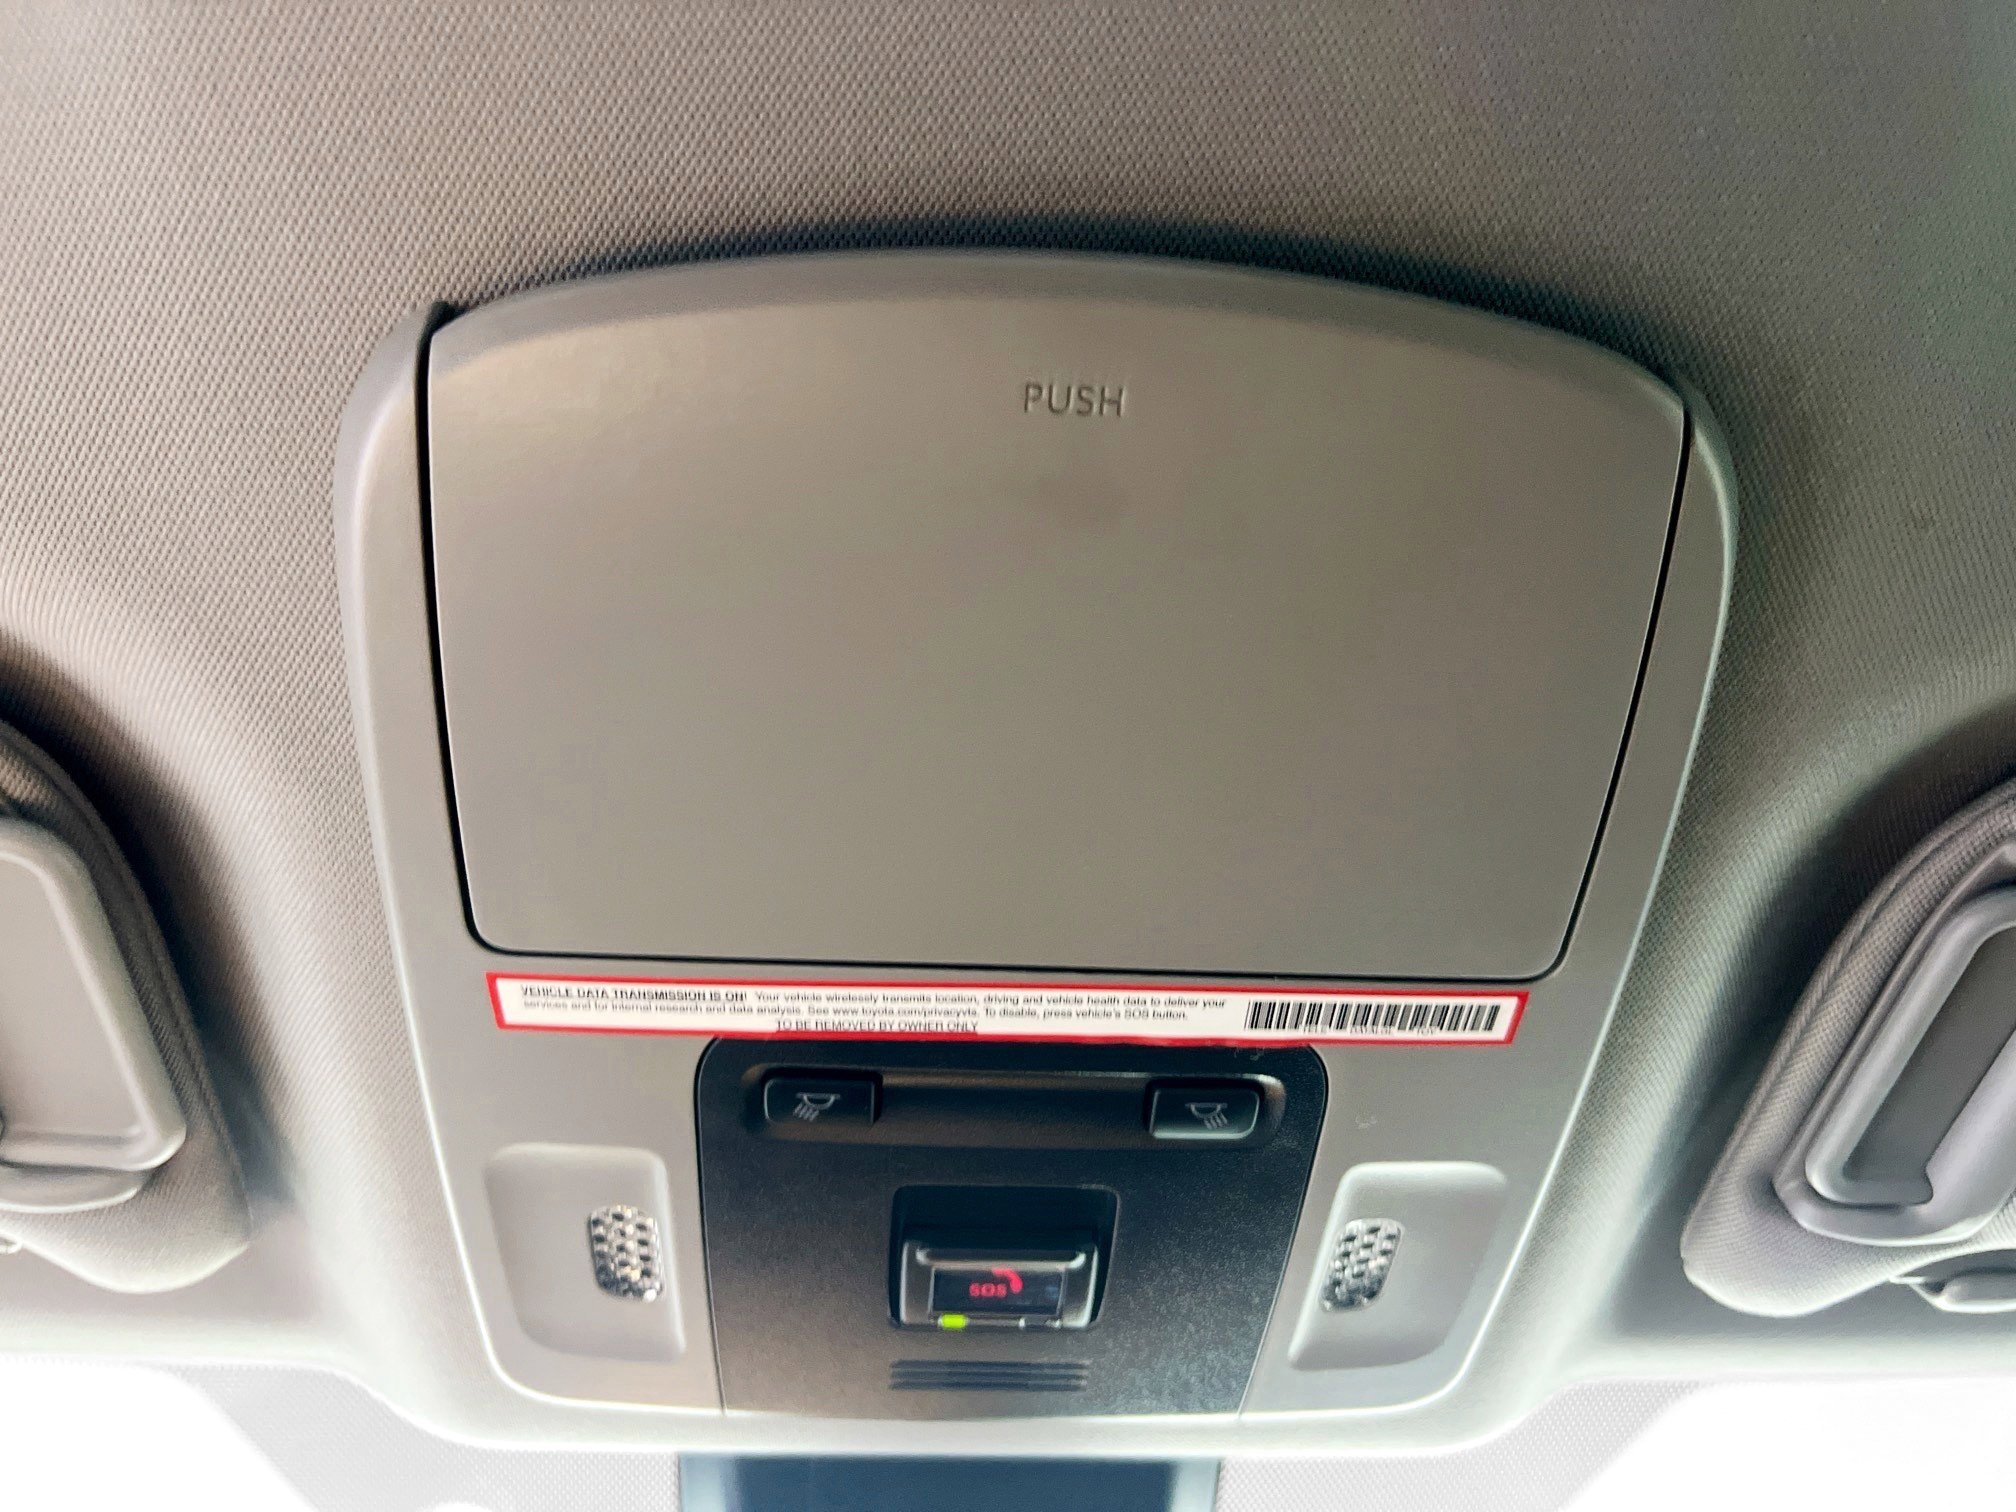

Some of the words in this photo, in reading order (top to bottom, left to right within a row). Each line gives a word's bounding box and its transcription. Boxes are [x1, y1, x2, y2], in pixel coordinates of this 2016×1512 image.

[1023, 381, 1126, 418] PUSH
[521, 984, 573, 997] VEHICLE
[577, 986, 609, 999] DATA
[610, 987, 706, 1001] TRANSMISSION
[709, 989, 721, 1001] IS
[755, 990, 780, 1002] Your
[784, 991, 822, 1003] vehicle
[826, 992, 879, 1005] wirelessly
[882, 992, 932, 1004] transmits
[935, 993, 979, 1006] location,
[983, 993, 1020, 1006] driving
[1022, 994, 1043, 1005] and
[1047, 994, 1083, 1005] vehicle
[1087, 994, 1120, 1006] health
[1123, 995, 1146, 1006] data
[1150, 996, 1161, 1006] to
[1164, 996, 1199, 1008] deliver
[1202, 999, 1226, 1011] your
[655, 1001, 703, 1013] research
[706, 1002, 726, 1013] and
[730, 1003, 753, 1014] data
[808, 1004, 829, 1014] See
[999, 1007, 1040, 1020] disable,
[1043, 1008, 1073, 1020] press
[1075, 1008, 1121, 1019] vehicle's
[1124, 1008, 1149, 1020] SOS
[775, 1019, 793, 1031] TO
[796, 1019, 812, 1031] BE
[815, 1019, 876, 1032] REMOVED
[879, 1020, 895, 1032] BY
[897, 1020, 944, 1032] OWNER
[947, 1020, 979, 1032] ONLY
[968, 1282, 1008, 1299] SOS
